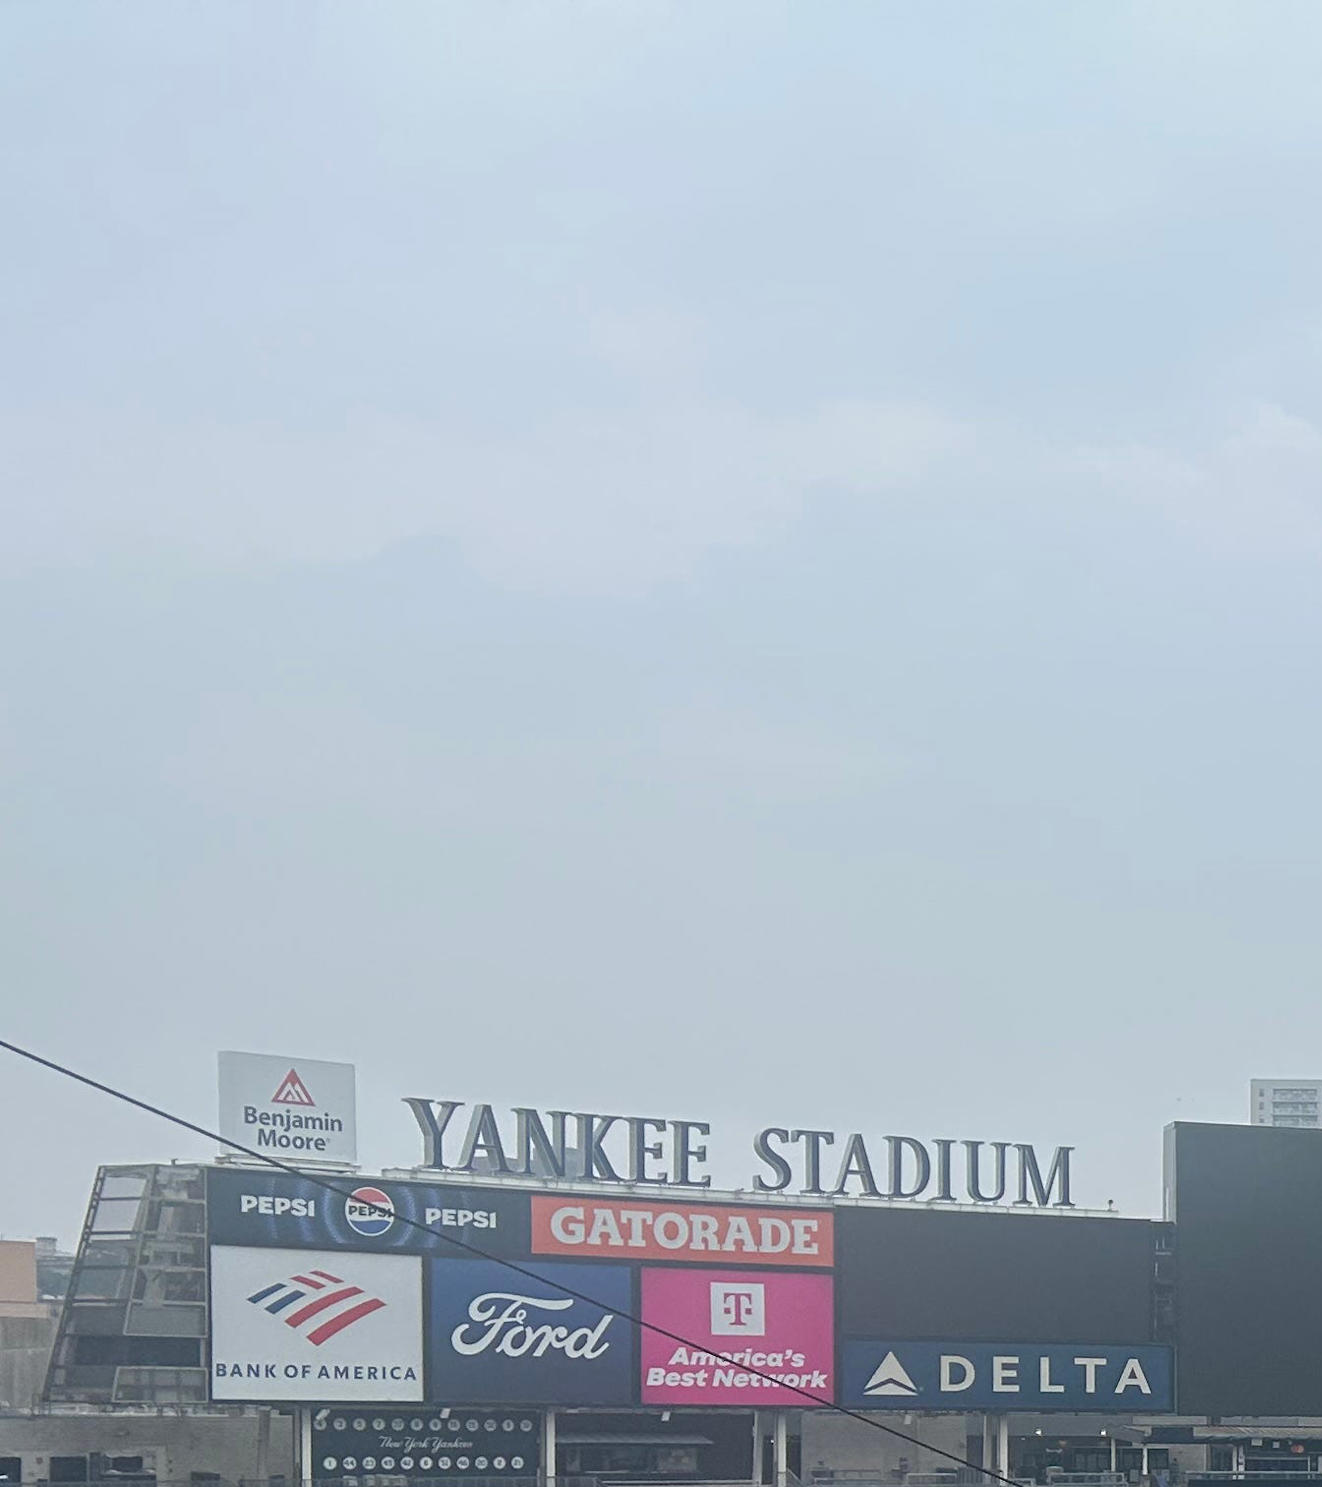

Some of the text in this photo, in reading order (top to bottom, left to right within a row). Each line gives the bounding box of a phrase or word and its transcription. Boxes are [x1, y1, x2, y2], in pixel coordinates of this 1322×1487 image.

[243, 1105, 343, 1136] Benjamin
[257, 1128, 330, 1152] Moore
[402, 1096, 1076, 1207] YANKEE STADIUM
[241, 1194, 315, 1217] PEPSI
[425, 1208, 497, 1229] PEPSI
[550, 1207, 819, 1255] GATORADE
[451, 1293, 614, 1360] Ford
[669, 1347, 806, 1369] America's
[216, 1363, 417, 1381] BANK OF AMERICA
[646, 1367, 828, 1391] Best Network
[940, 1354, 1153, 1395] DELTA
[379, 1436, 400, 1448] New
[403, 1436, 428, 1453] York
